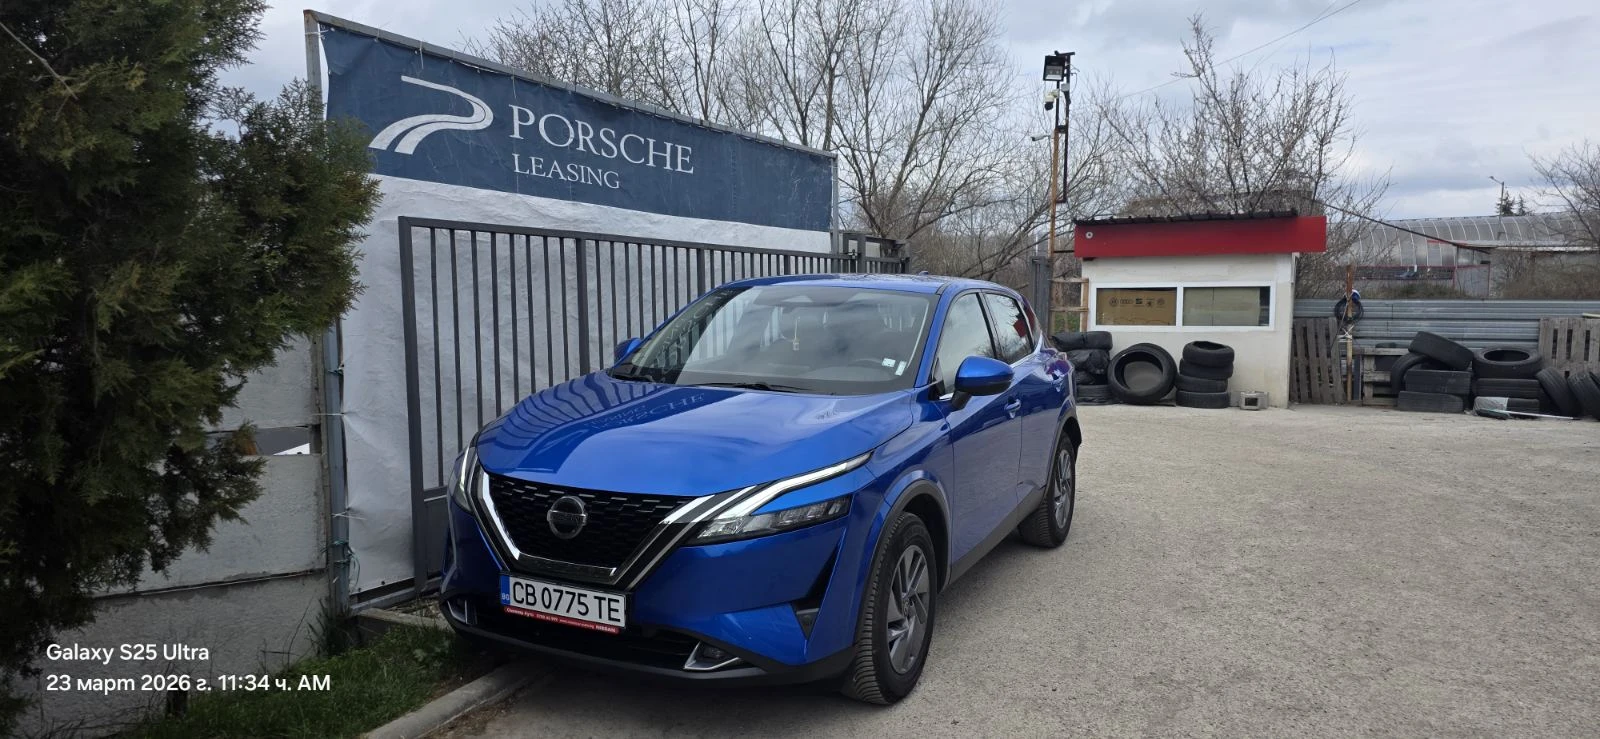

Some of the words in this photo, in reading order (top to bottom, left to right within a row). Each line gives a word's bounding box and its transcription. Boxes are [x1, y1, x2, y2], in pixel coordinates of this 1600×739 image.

[508, 104, 694, 175] PORSCHE
[512, 153, 620, 190] LEASING
[513, 581, 537, 606] CB
[541, 587, 589, 616] 0775
[594, 596, 620, 622] TE
